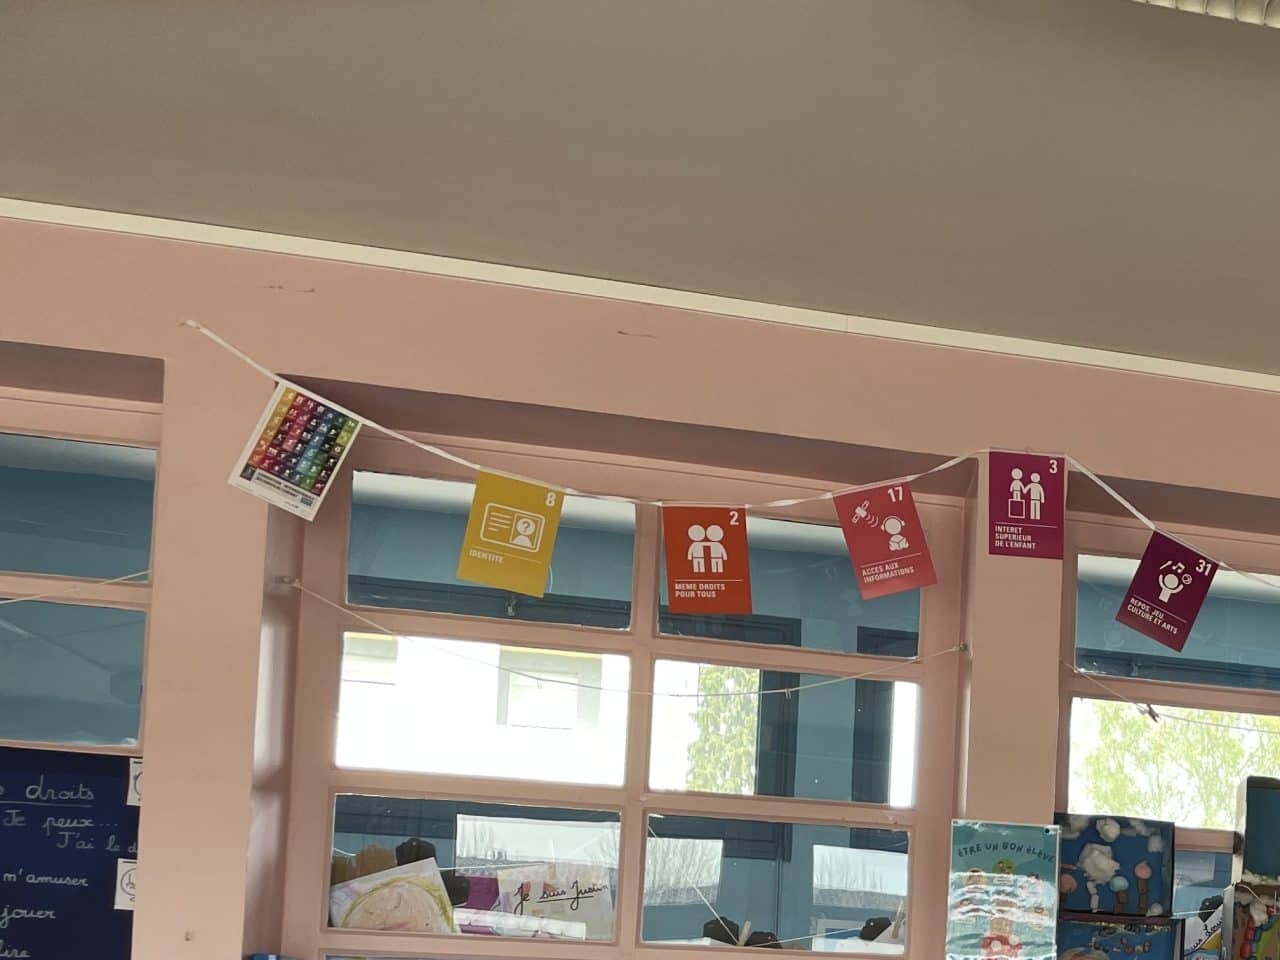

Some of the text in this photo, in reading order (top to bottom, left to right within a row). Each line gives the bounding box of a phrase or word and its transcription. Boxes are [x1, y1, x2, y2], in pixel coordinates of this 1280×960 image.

[1049, 459, 1058, 473] 3
[545, 491, 556, 507] 8
[887, 486, 903, 502] 17
[729, 511, 740, 525] 2
[995, 533, 1032, 541] SUPERIEUR
[995, 540, 1036, 549] DE L'ENFANT
[862, 562, 899, 577] ACCES AUX
[863, 566, 914, 584] INFORMATIONS
[1195, 559, 1212, 576] 31
[675, 583, 726, 591] MEME DROITS
[675, 590, 717, 598] POUR TOUS
[1127, 604, 1179, 635] CULTURE ET ARTS
[25, 774, 95, 800] droits
[4, 809, 27, 826] Je
[56, 831, 95, 849] J'ai
[1001, 842, 1024, 853] BON
[513, 883, 531, 915] Je
[540, 888, 563, 899] suis
